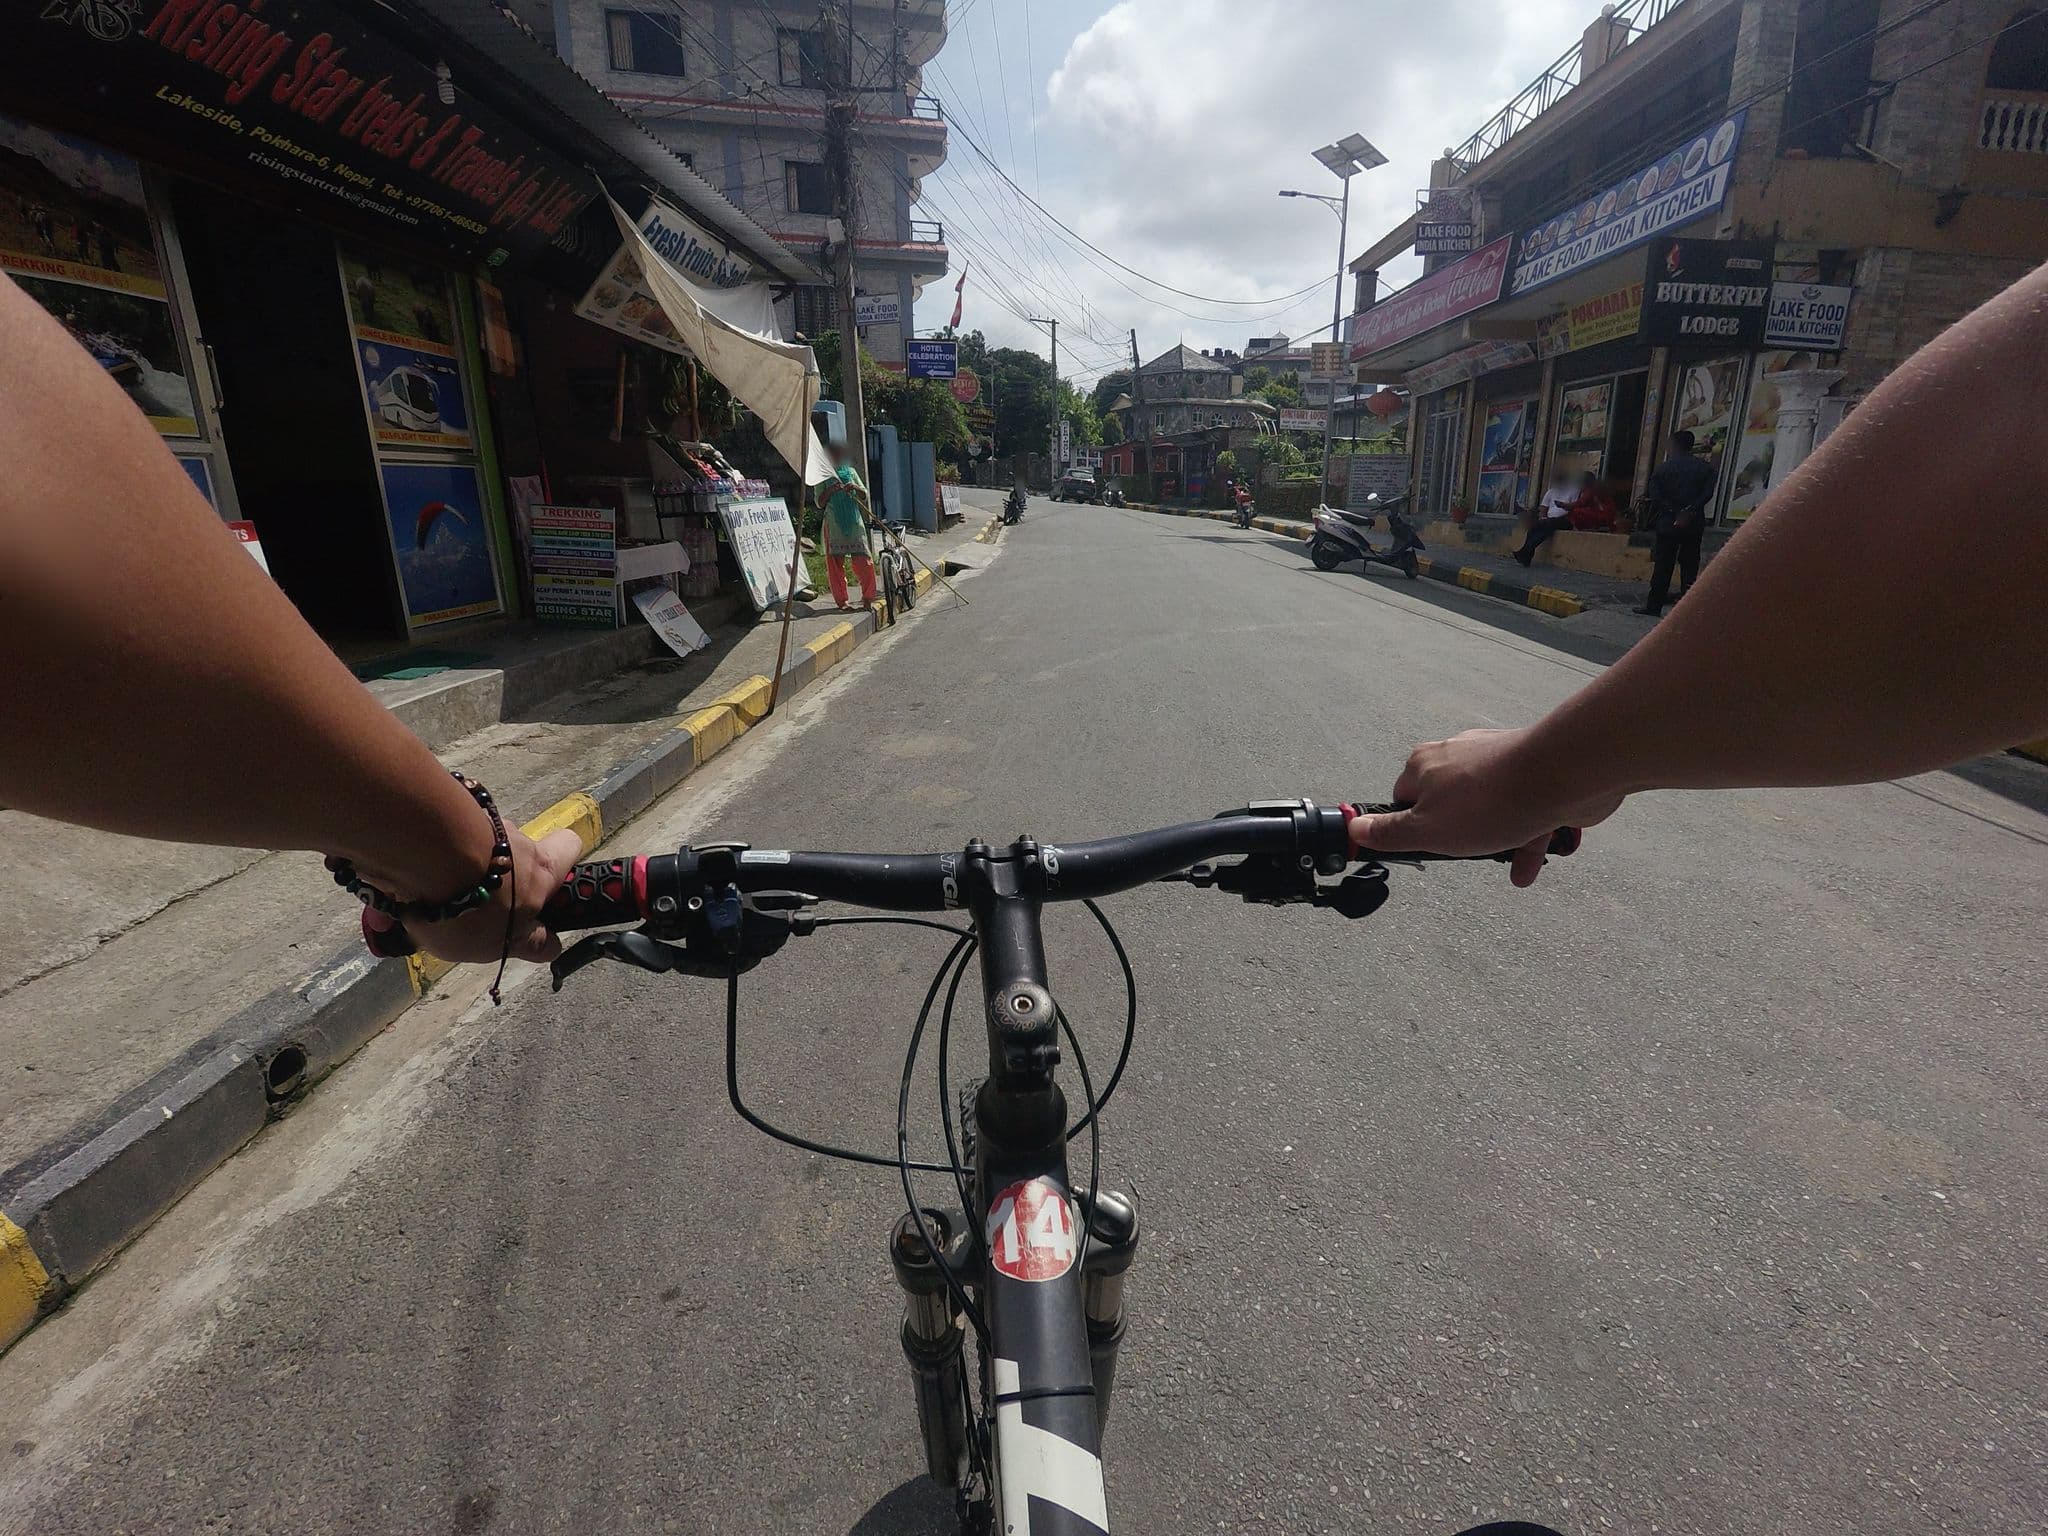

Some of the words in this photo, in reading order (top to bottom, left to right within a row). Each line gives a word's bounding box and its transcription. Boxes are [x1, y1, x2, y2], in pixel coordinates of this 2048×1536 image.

[271, 33, 364, 126] Star
[155, 85, 245, 135] Lakeside,
[249, 125, 331, 171] Pokhara-6,
[332, 162, 376, 189] Nepal,
[247, 151, 420, 226] risingstartreks@gmail.com
[643, 214, 688, 264] Fresh
[1418, 225, 1444, 238] LAKE
[1444, 225, 1472, 237] FOOD
[1523, 262, 1552, 285] LAKE
[1555, 239, 1593, 272] FOOD
[1594, 221, 1636, 256] INDIA
[1639, 174, 1718, 233] KITCHEN
[1416, 240, 1438, 251] INDIA
[1438, 239, 1471, 251] KITCHEN
[0, 254, 65, 276] REKKING
[1655, 282, 1768, 307] BUTTERFLY
[856, 304, 876, 314] LAKE
[877, 303, 898, 313] FOOD
[1771, 300, 1804, 318] LAKE
[1807, 302, 1845, 321] FOOD
[1680, 315, 1740, 335] LODGE
[1767, 319, 1796, 333] INDIA
[1798, 320, 1842, 336] KITCHEN
[908, 352, 956, 362] CELEBRATION
[920, 344, 943, 353] HOTEL
[541, 508, 602, 519] TREKKING
[727, 509, 748, 529] 100%
[748, 507, 768, 525] Fresh
[767, 506, 786, 522] Juice
[536, 605, 577, 616] RISING
[580, 607, 612, 617] STAR
[985, 1195, 1070, 1264] 14
